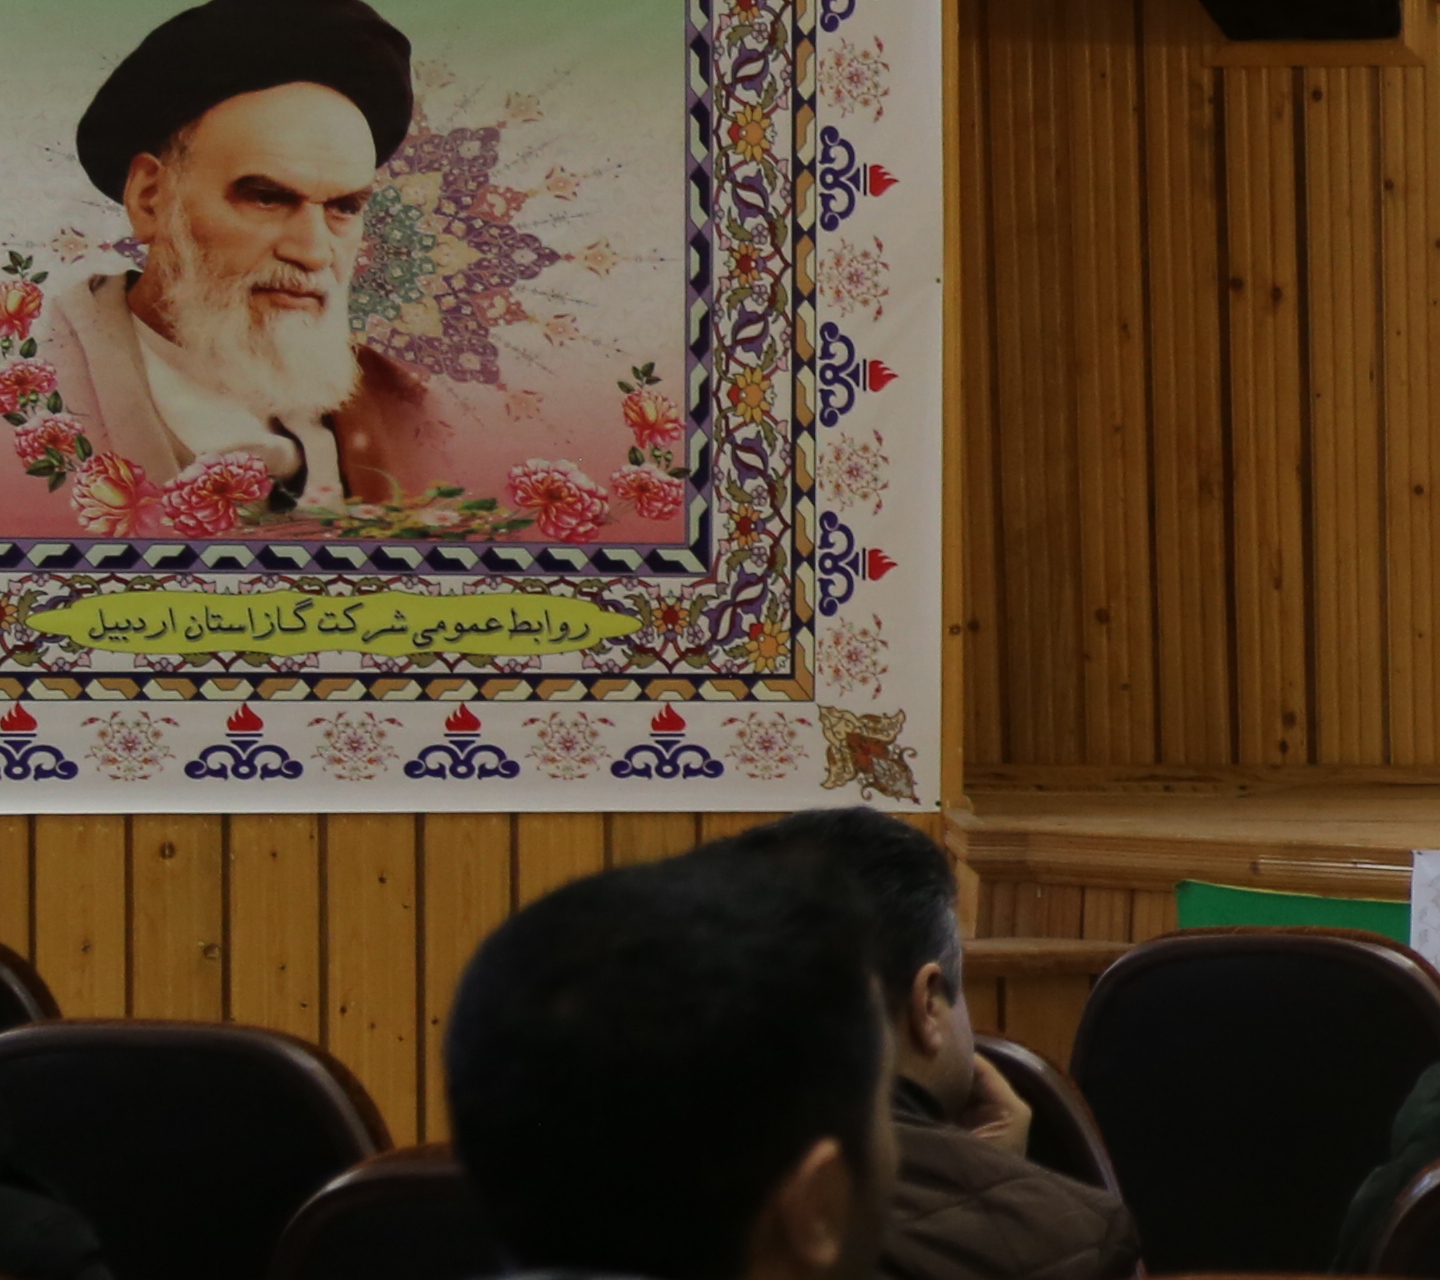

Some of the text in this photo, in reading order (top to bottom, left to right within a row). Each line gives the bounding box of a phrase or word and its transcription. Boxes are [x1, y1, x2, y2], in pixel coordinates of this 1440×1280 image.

[88, 598, 591, 648] روابط عمومی شرکت گاز استان اردبیل
